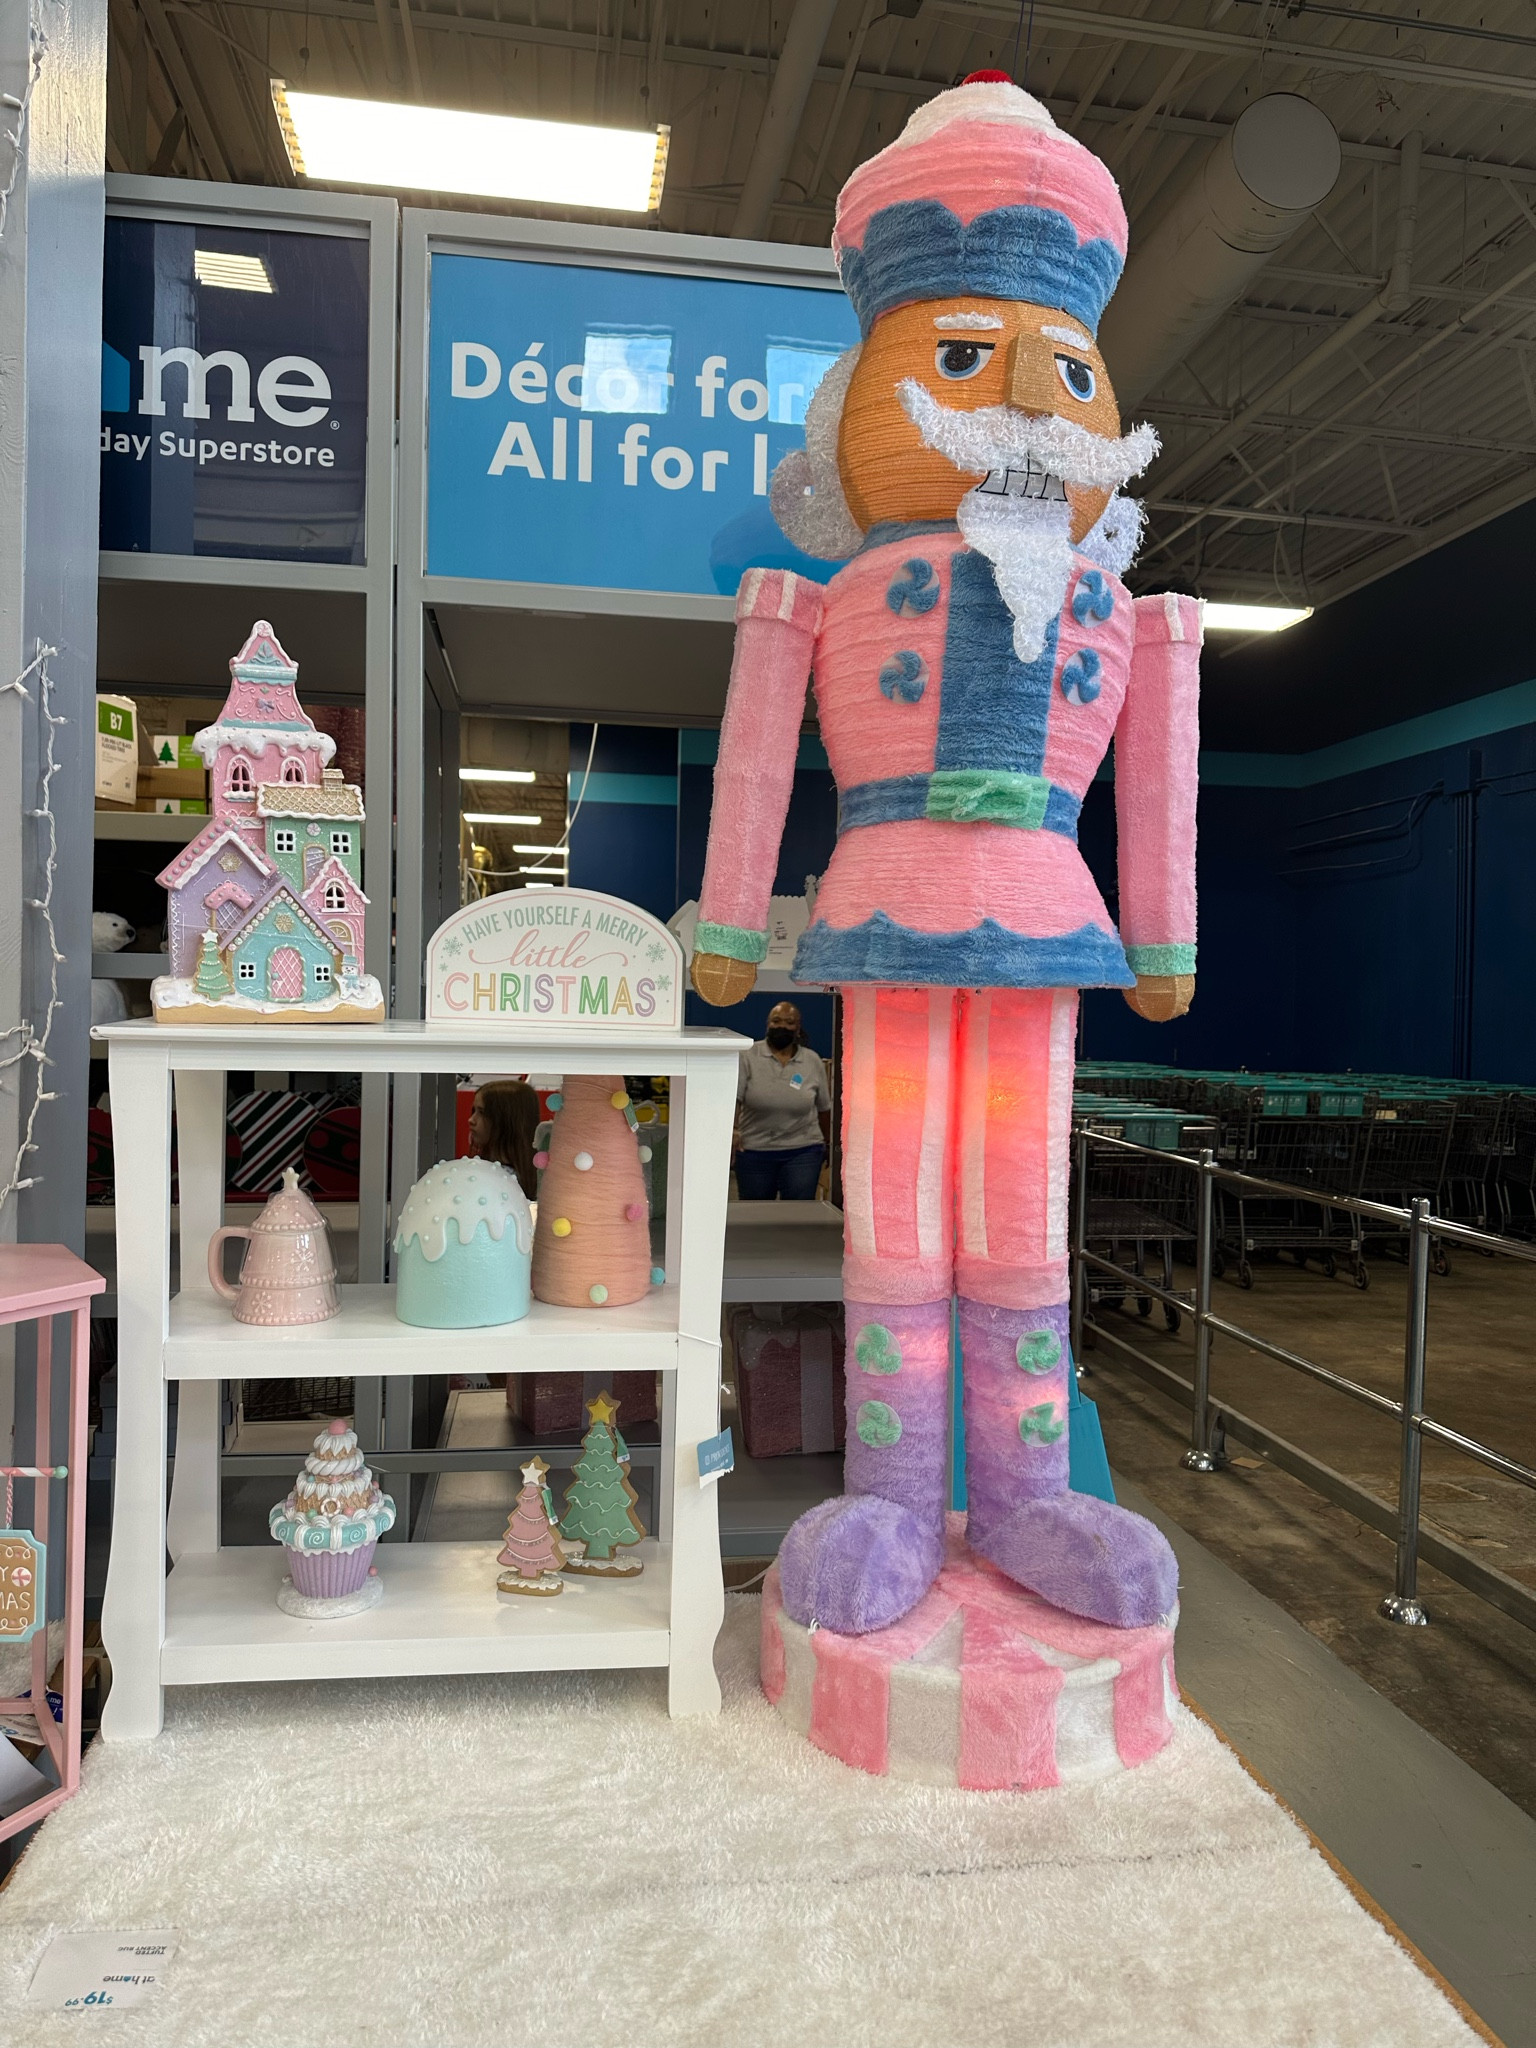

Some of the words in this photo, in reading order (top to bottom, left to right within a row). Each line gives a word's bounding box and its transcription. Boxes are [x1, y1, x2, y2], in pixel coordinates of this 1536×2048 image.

[451, 341, 674, 410] Décor
[695, 355, 804, 425] for
[159, 430, 335, 467] Superstore
[487, 417, 593, 483] All
[618, 423, 729, 492] for
[110, 711, 123, 731] B7
[461, 913, 502, 943] HAVE
[503, 905, 580, 929] YOURSELF
[581, 910, 592, 929] A
[595, 912, 649, 947] MERRY
[468, 929, 628, 968] little
[444, 972, 656, 1017] CHRISTMAS
[64, 1990, 113, 2006] $19.99
[141, 1976, 155, 1984] at
